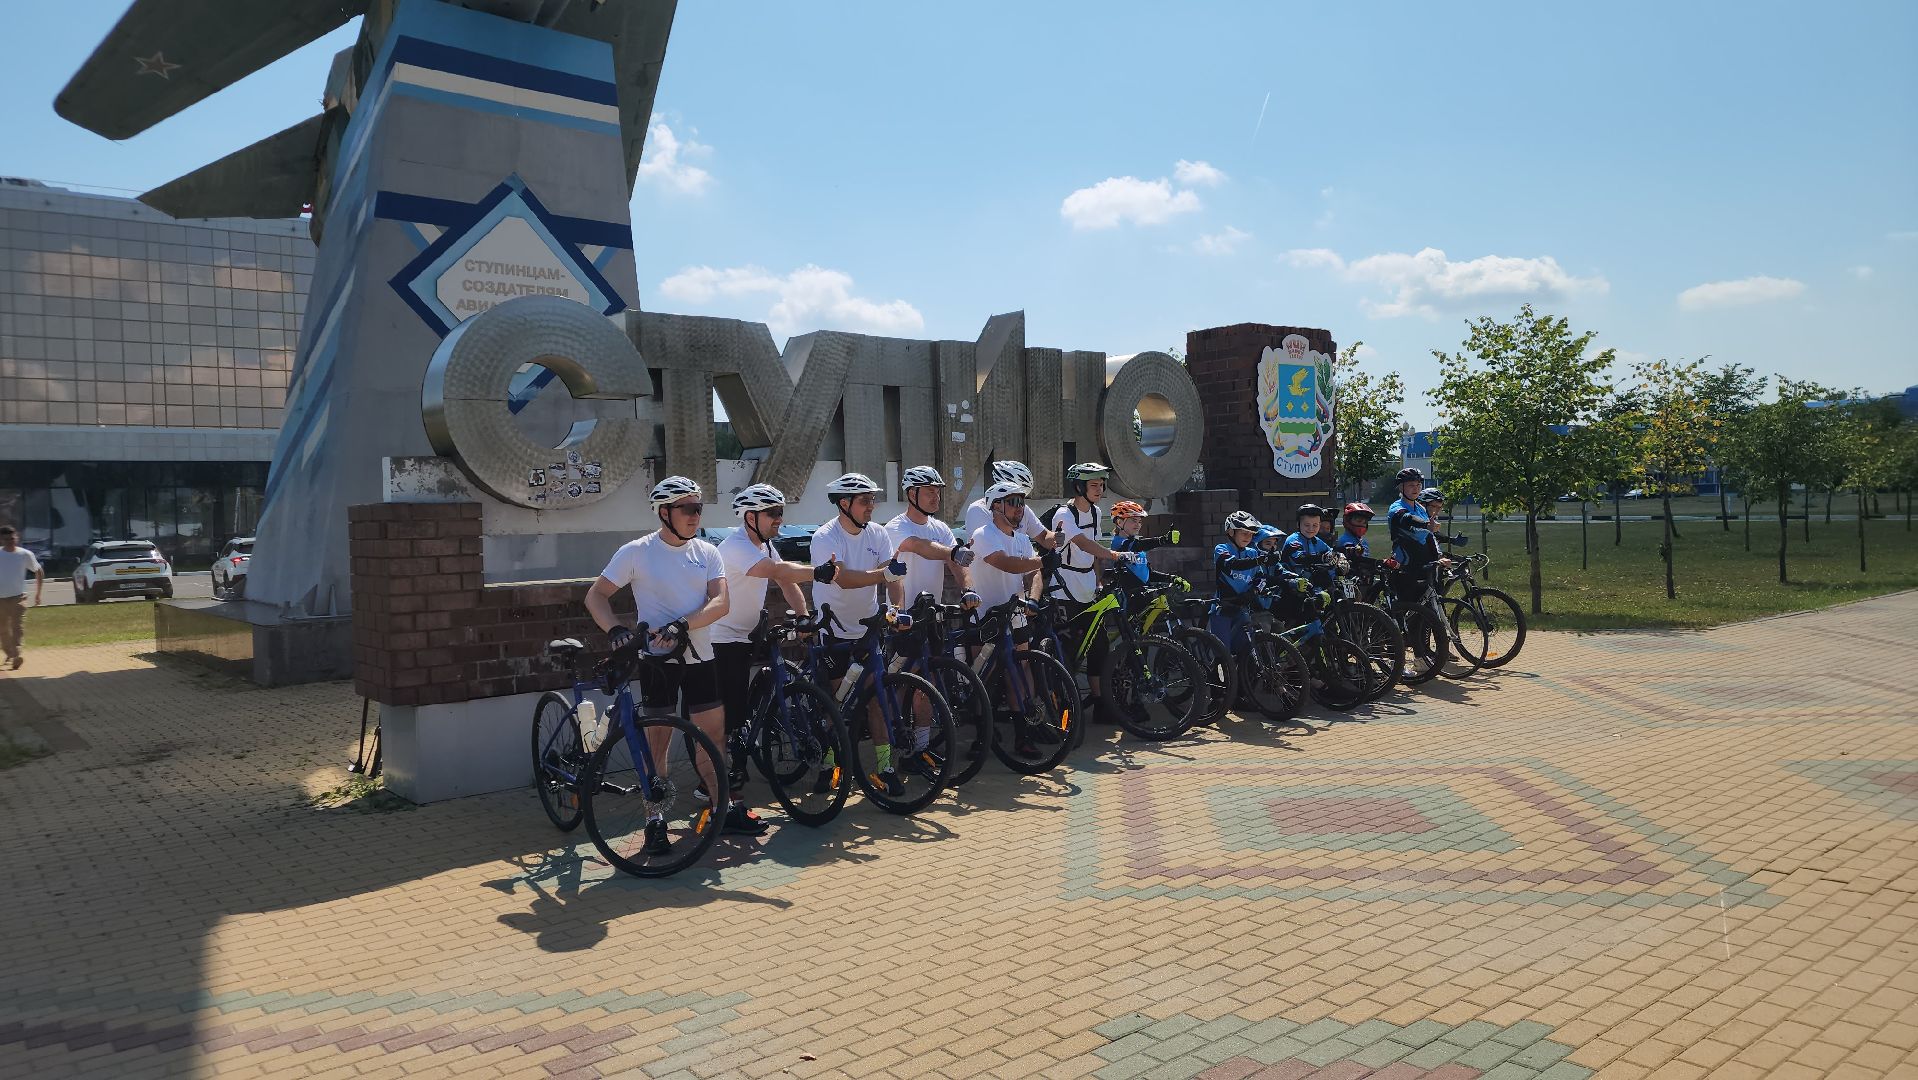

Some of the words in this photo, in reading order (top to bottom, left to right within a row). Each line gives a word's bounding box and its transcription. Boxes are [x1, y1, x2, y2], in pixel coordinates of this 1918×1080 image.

[464, 260, 566, 280] СТУПИНЦАМ-
[422, 294, 1206, 514] СТУПИНО
[1276, 456, 1319, 474] СТУПИНО
